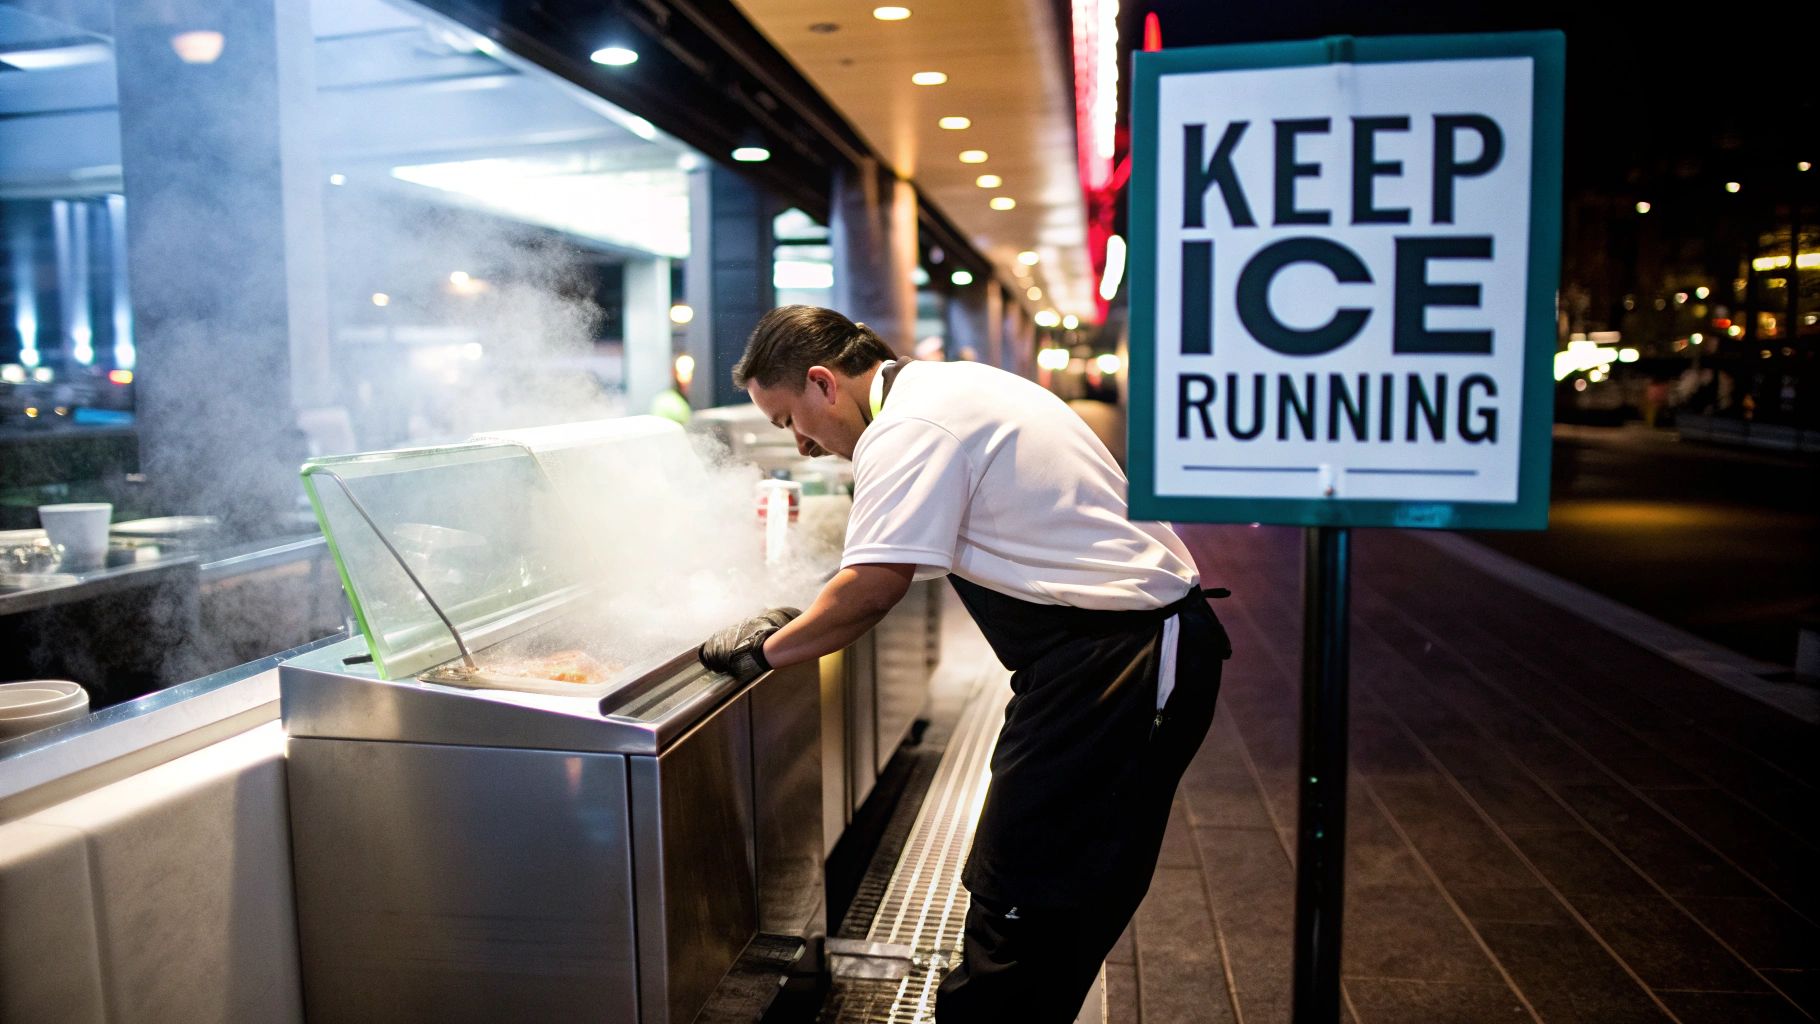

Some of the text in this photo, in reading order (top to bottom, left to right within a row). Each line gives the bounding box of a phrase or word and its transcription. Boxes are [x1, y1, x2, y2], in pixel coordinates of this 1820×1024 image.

[1182, 113, 1505, 229] KEEP
[1180, 235, 1494, 357] ICE
[1177, 372, 1499, 445] RUNNING
